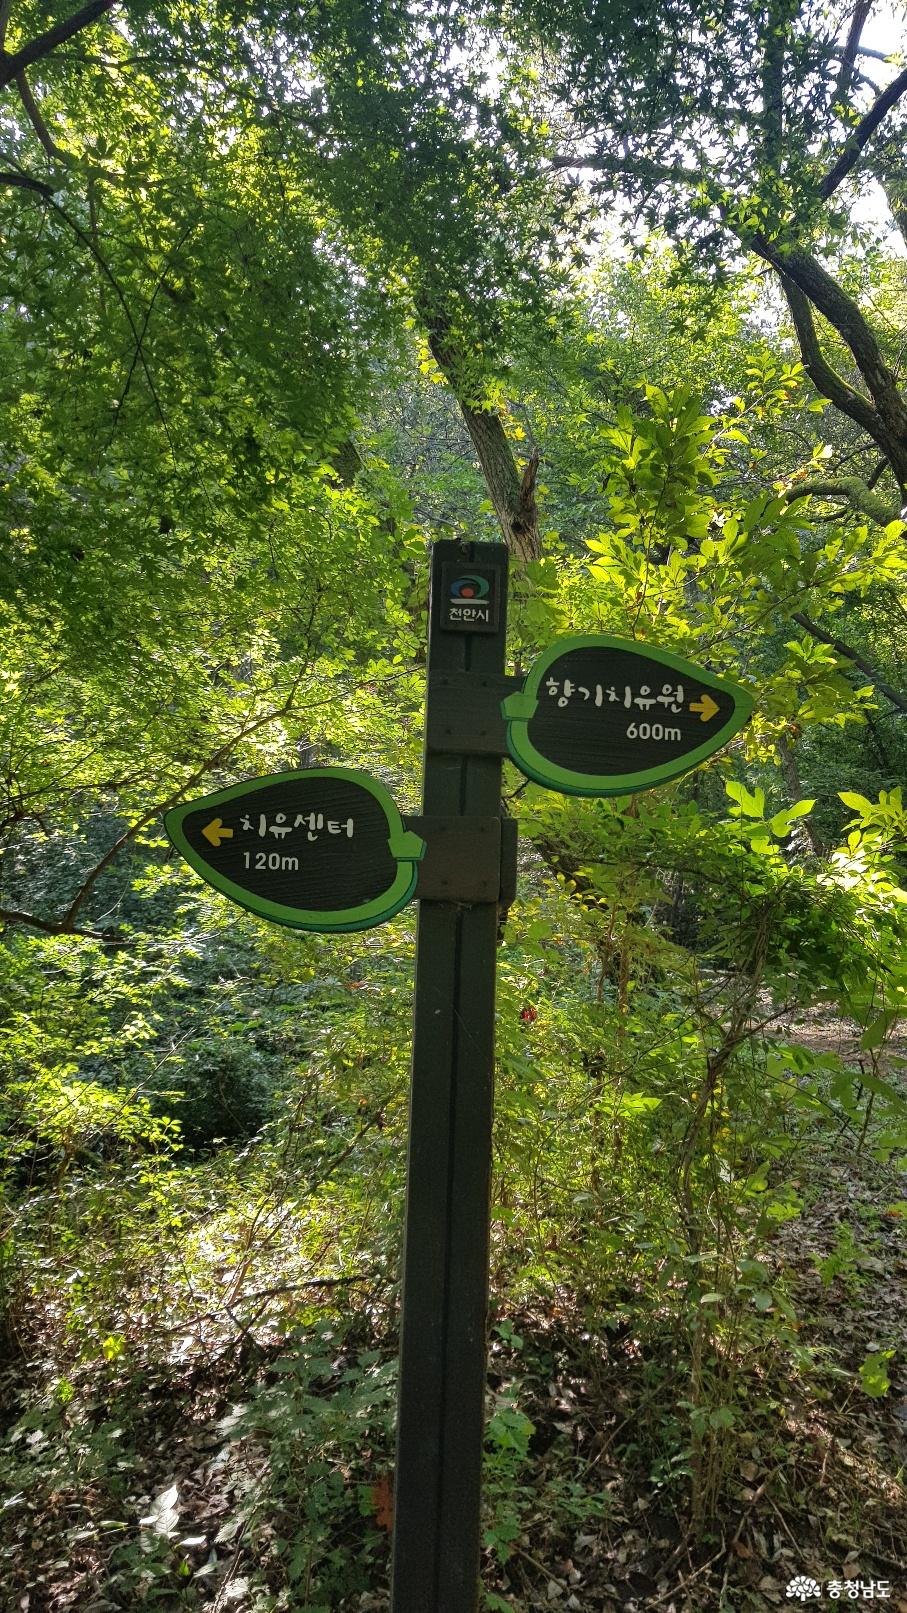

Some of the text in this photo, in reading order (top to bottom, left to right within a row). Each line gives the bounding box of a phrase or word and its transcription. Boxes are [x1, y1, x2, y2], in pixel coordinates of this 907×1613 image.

[449, 608, 489, 622] 천안시
[546, 677, 684, 713] 향기치유원
[626, 722, 681, 741] 600m
[240, 812, 353, 841] 치유센터
[243, 852, 299, 870] 120m
